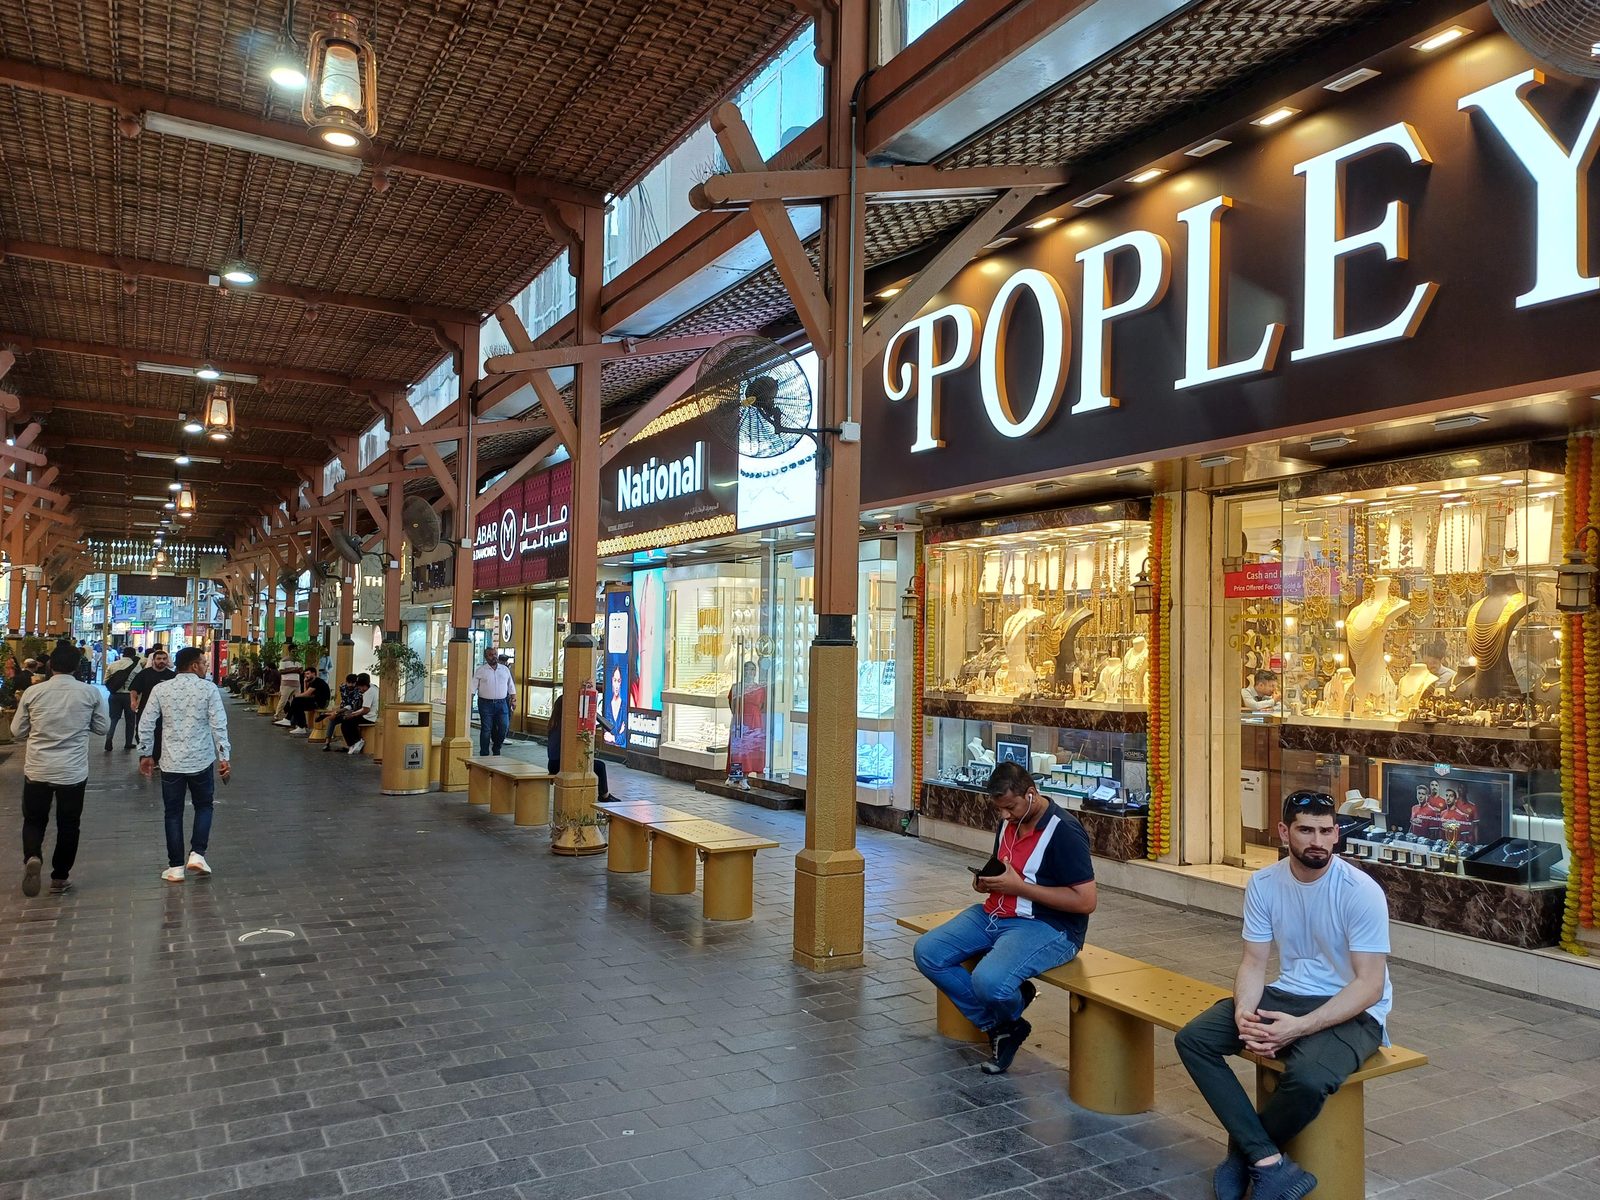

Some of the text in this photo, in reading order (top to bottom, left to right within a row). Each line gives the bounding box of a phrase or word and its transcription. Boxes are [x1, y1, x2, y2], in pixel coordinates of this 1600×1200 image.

[882, 69, 1600, 453] POPLEY
[617, 441, 703, 512] National
[1246, 571, 1263, 580] Cash
[1264, 570, 1278, 579] and
